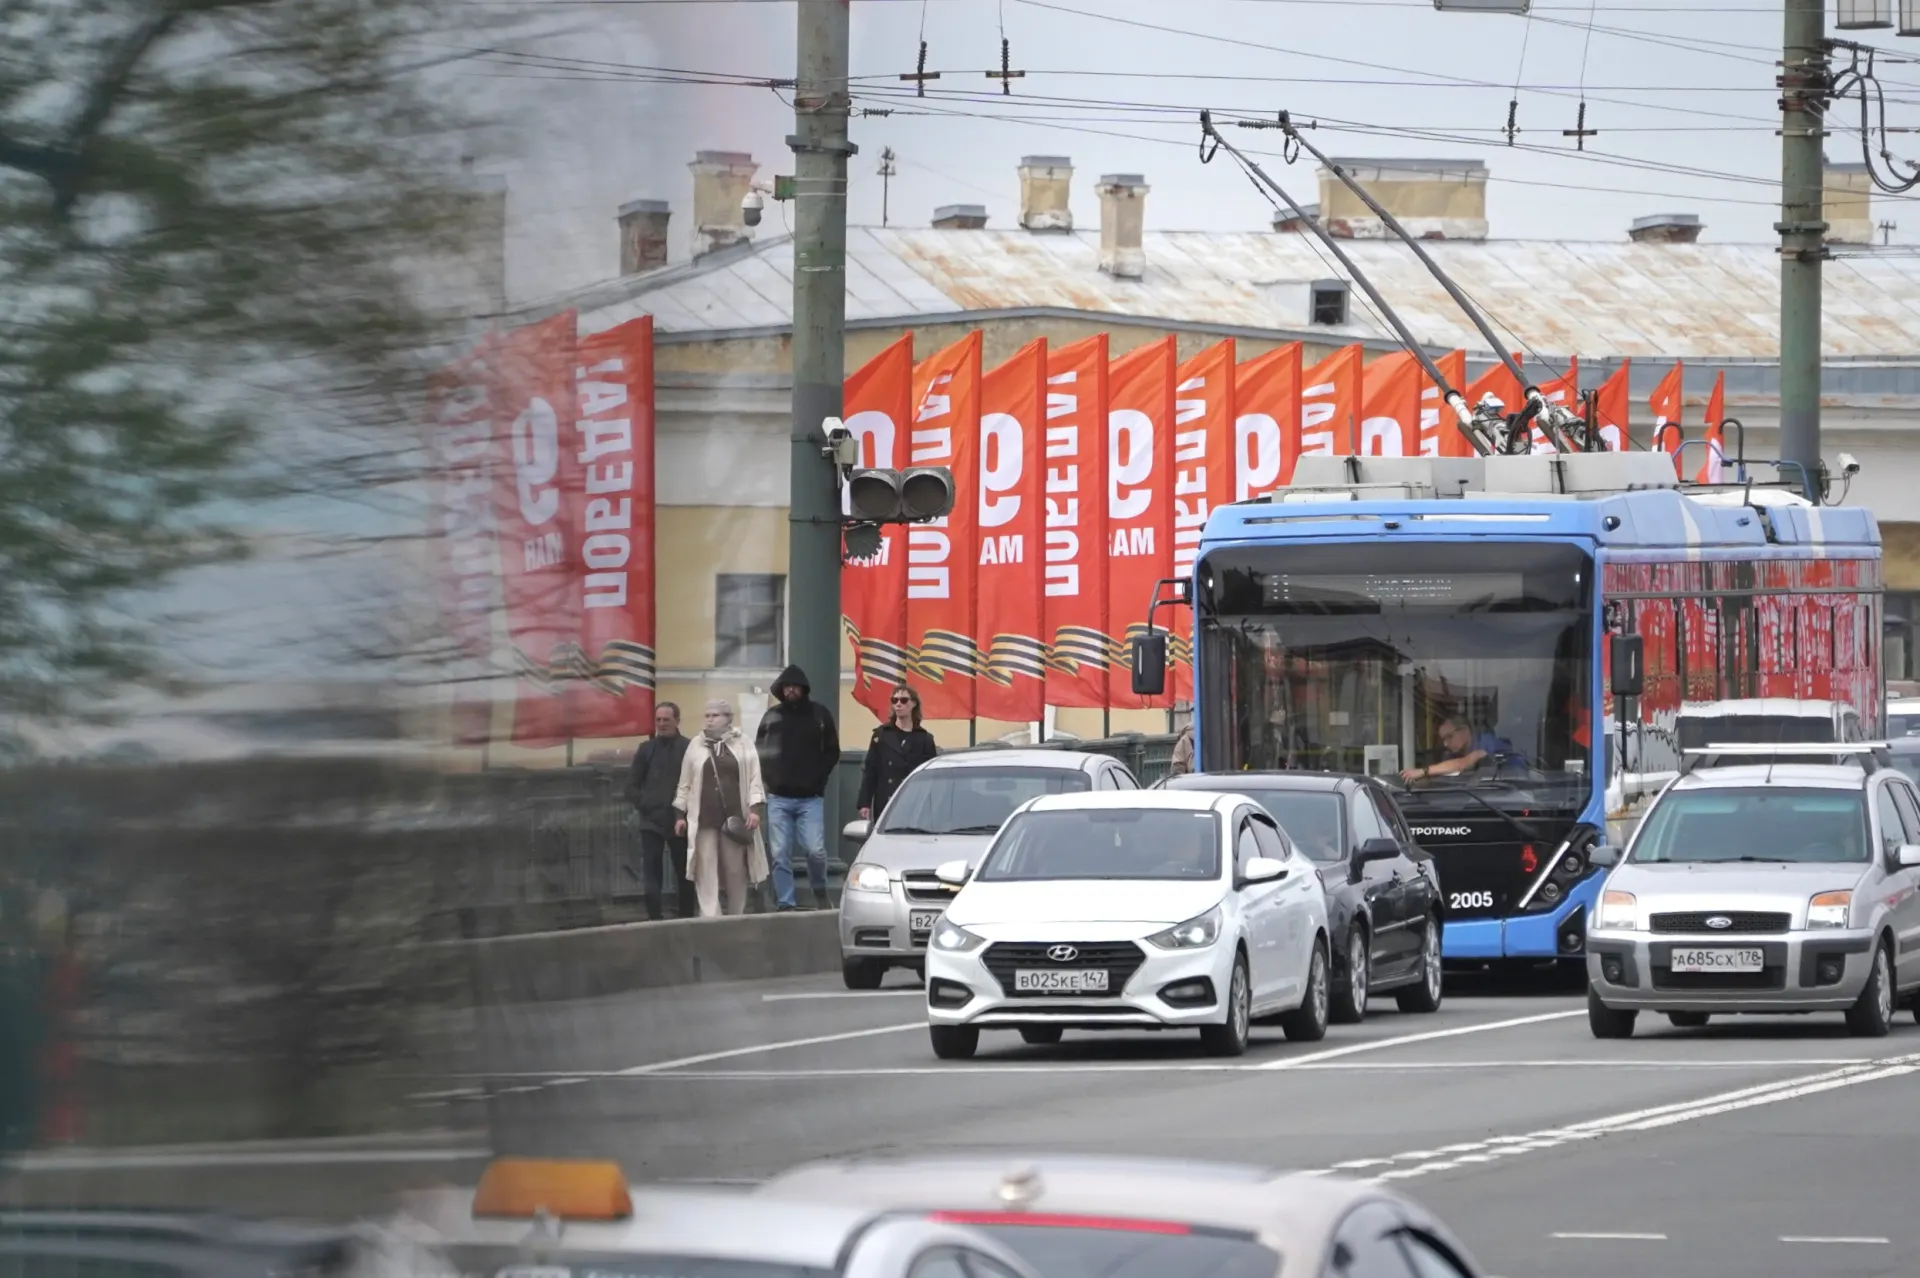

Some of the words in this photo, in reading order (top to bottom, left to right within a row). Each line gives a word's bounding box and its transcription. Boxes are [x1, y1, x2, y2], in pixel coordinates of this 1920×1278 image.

[1409, 826, 1472, 836] ТРОТРАНС»
[1450, 890, 1494, 909] 2005
[1020, 972, 1079, 988] В025КЕ
